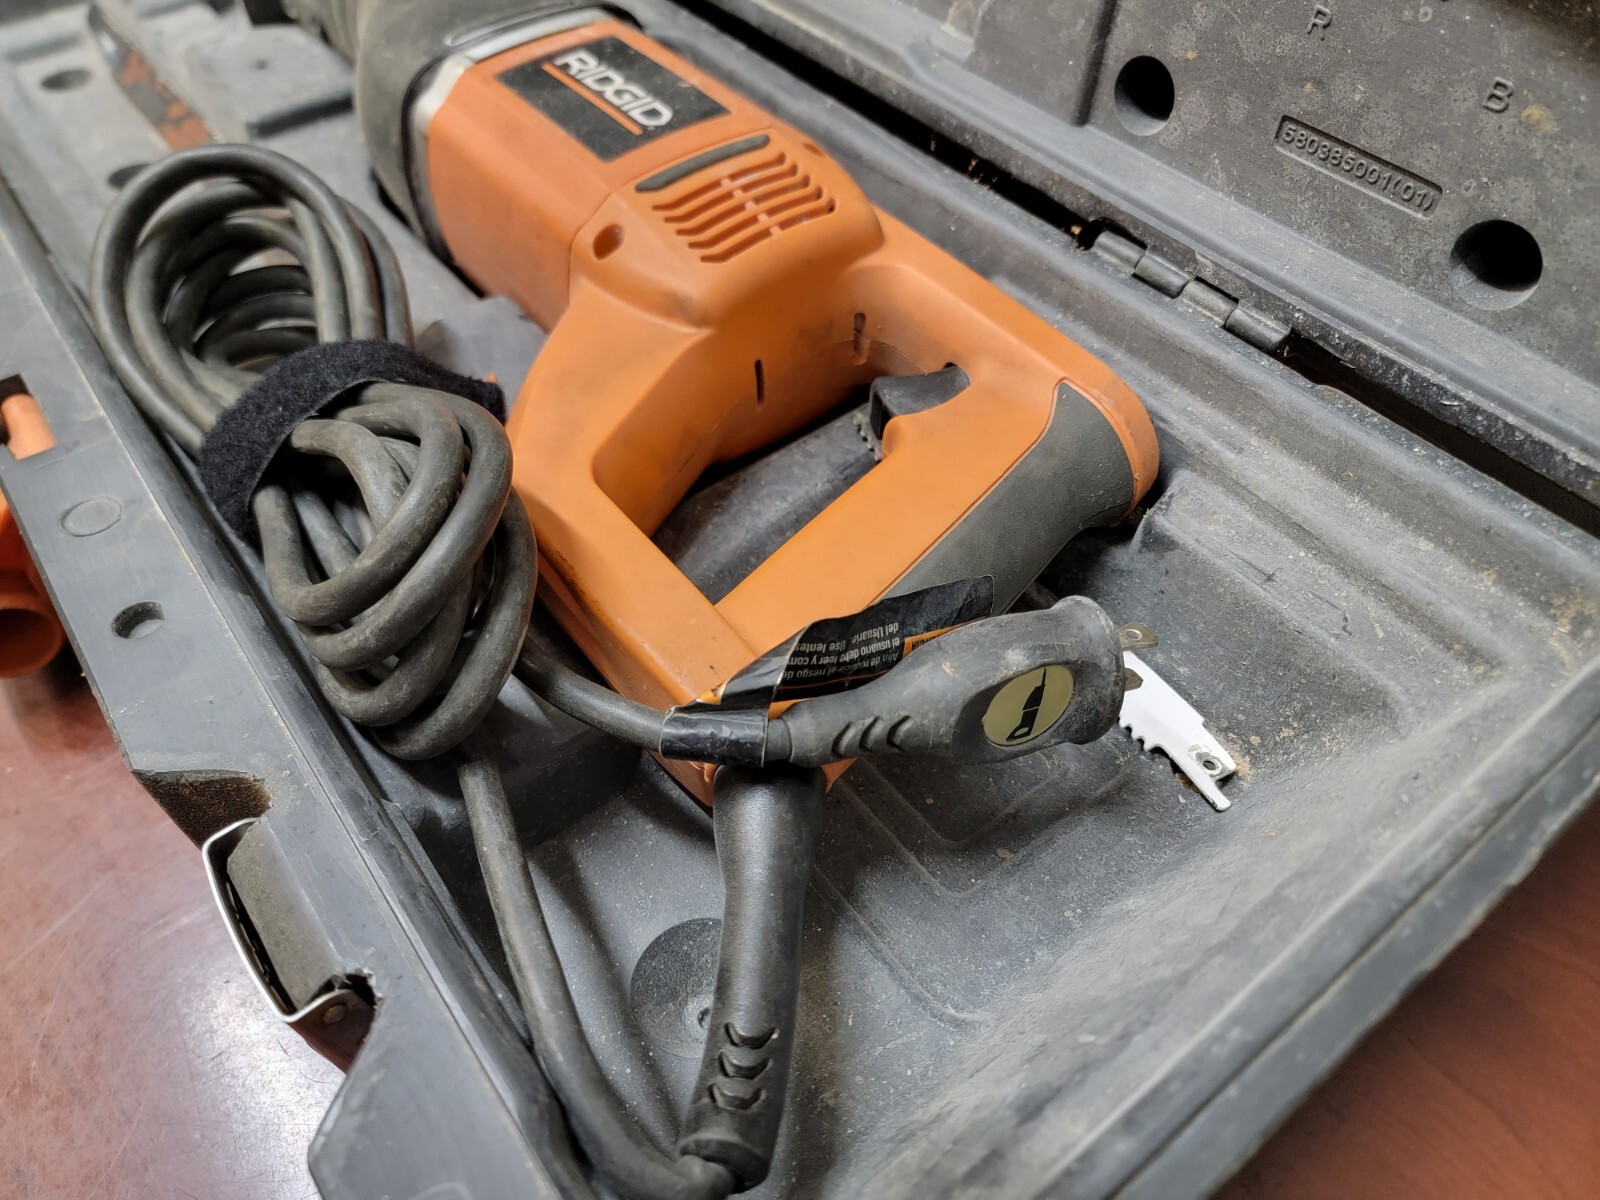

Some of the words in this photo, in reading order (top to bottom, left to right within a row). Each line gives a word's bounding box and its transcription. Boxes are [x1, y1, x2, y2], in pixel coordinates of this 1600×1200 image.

[1306, 3, 1333, 41] R
[552, 49, 674, 128] RIDGID
[1482, 75, 1514, 113] B
[1280, 123, 1436, 212] 580385001(01)
[885, 622, 899, 636] del
[830, 640, 846, 652] Use
[860, 641, 891, 657] usuario
[892, 637, 900, 649] el
[811, 654, 818, 665] y
[819, 655, 838, 665] leer
[840, 648, 860, 663] debe
[796, 666, 826, 679] riesgo
